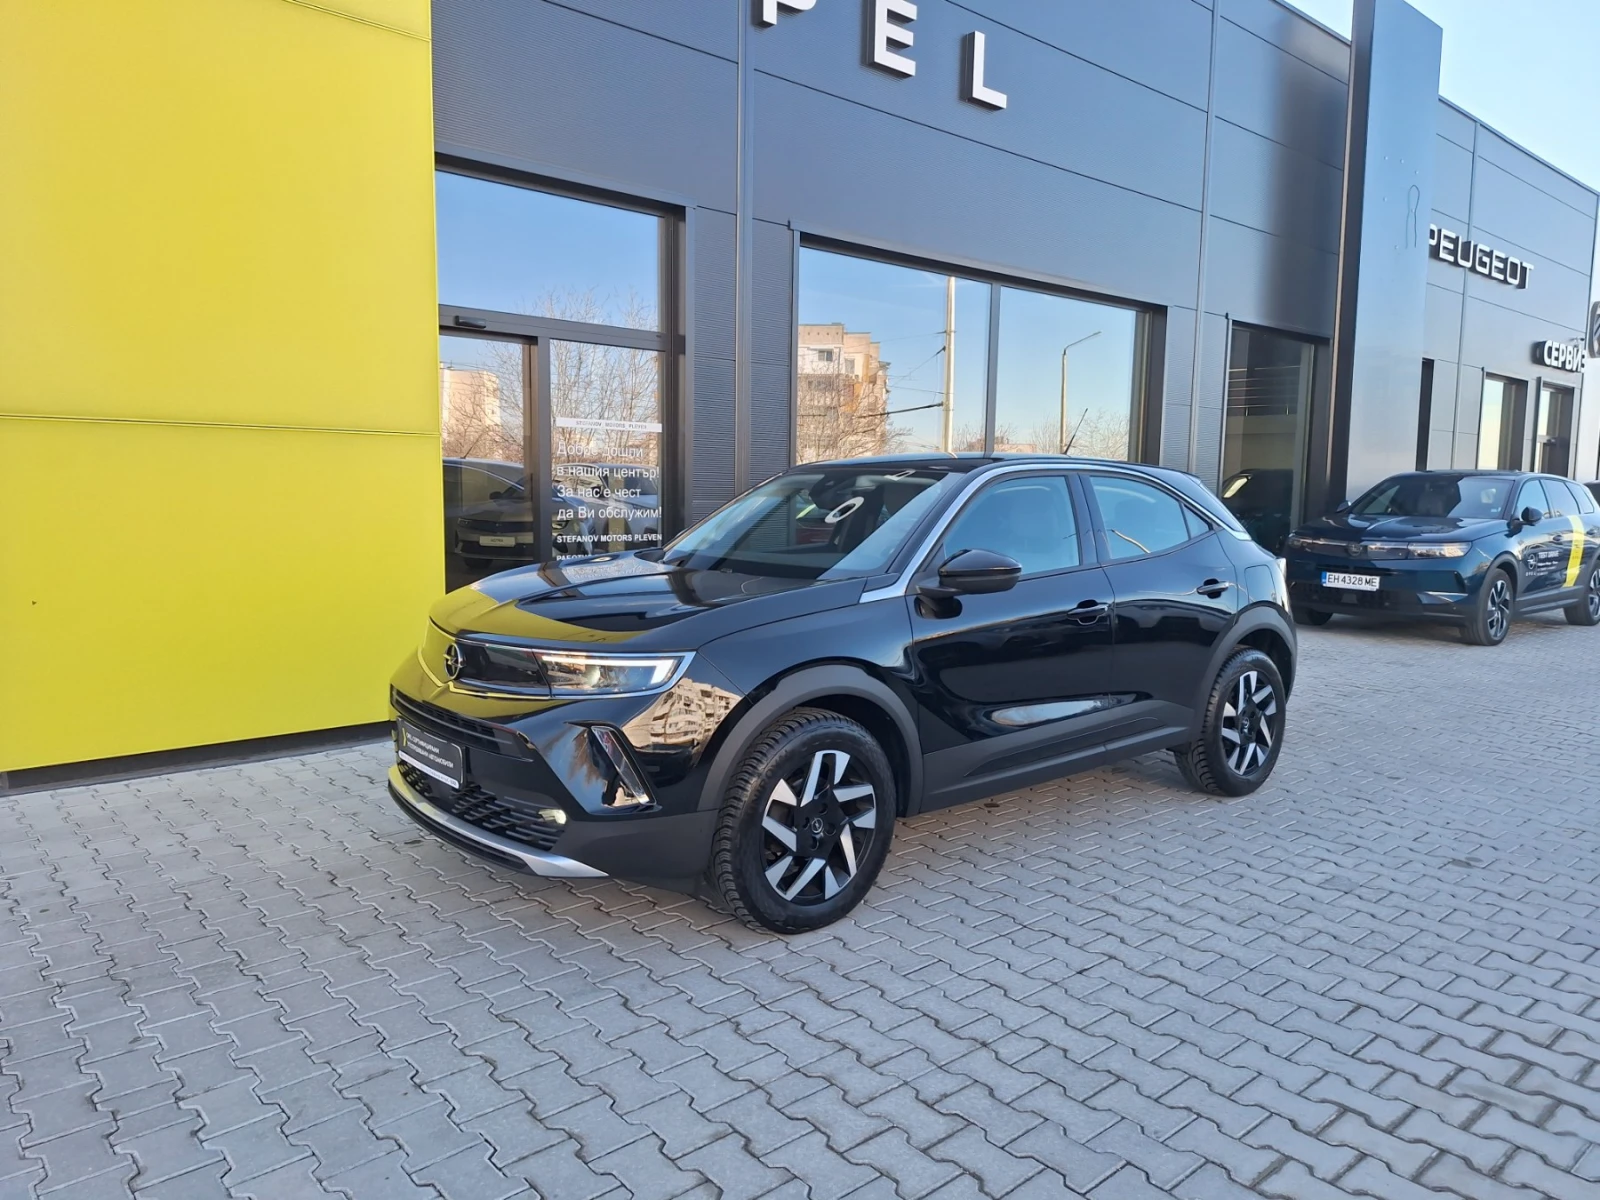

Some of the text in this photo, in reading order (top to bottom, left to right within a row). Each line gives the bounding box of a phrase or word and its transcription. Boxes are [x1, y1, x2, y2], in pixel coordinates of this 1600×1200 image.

[760, 0, 1007, 110] EL
[1544, 340, 1586, 373] СЕРВИЗ
[557, 441, 643, 457] Добре дошли
[557, 466, 660, 480] в нашия център!
[557, 485, 642, 498] За нас е чест
[557, 506, 662, 521] да Ви обслужим!
[556, 533, 662, 543] STEFANOV MOTORS PLEVEN
[1327, 574, 1378, 588] EH 4328 ME
